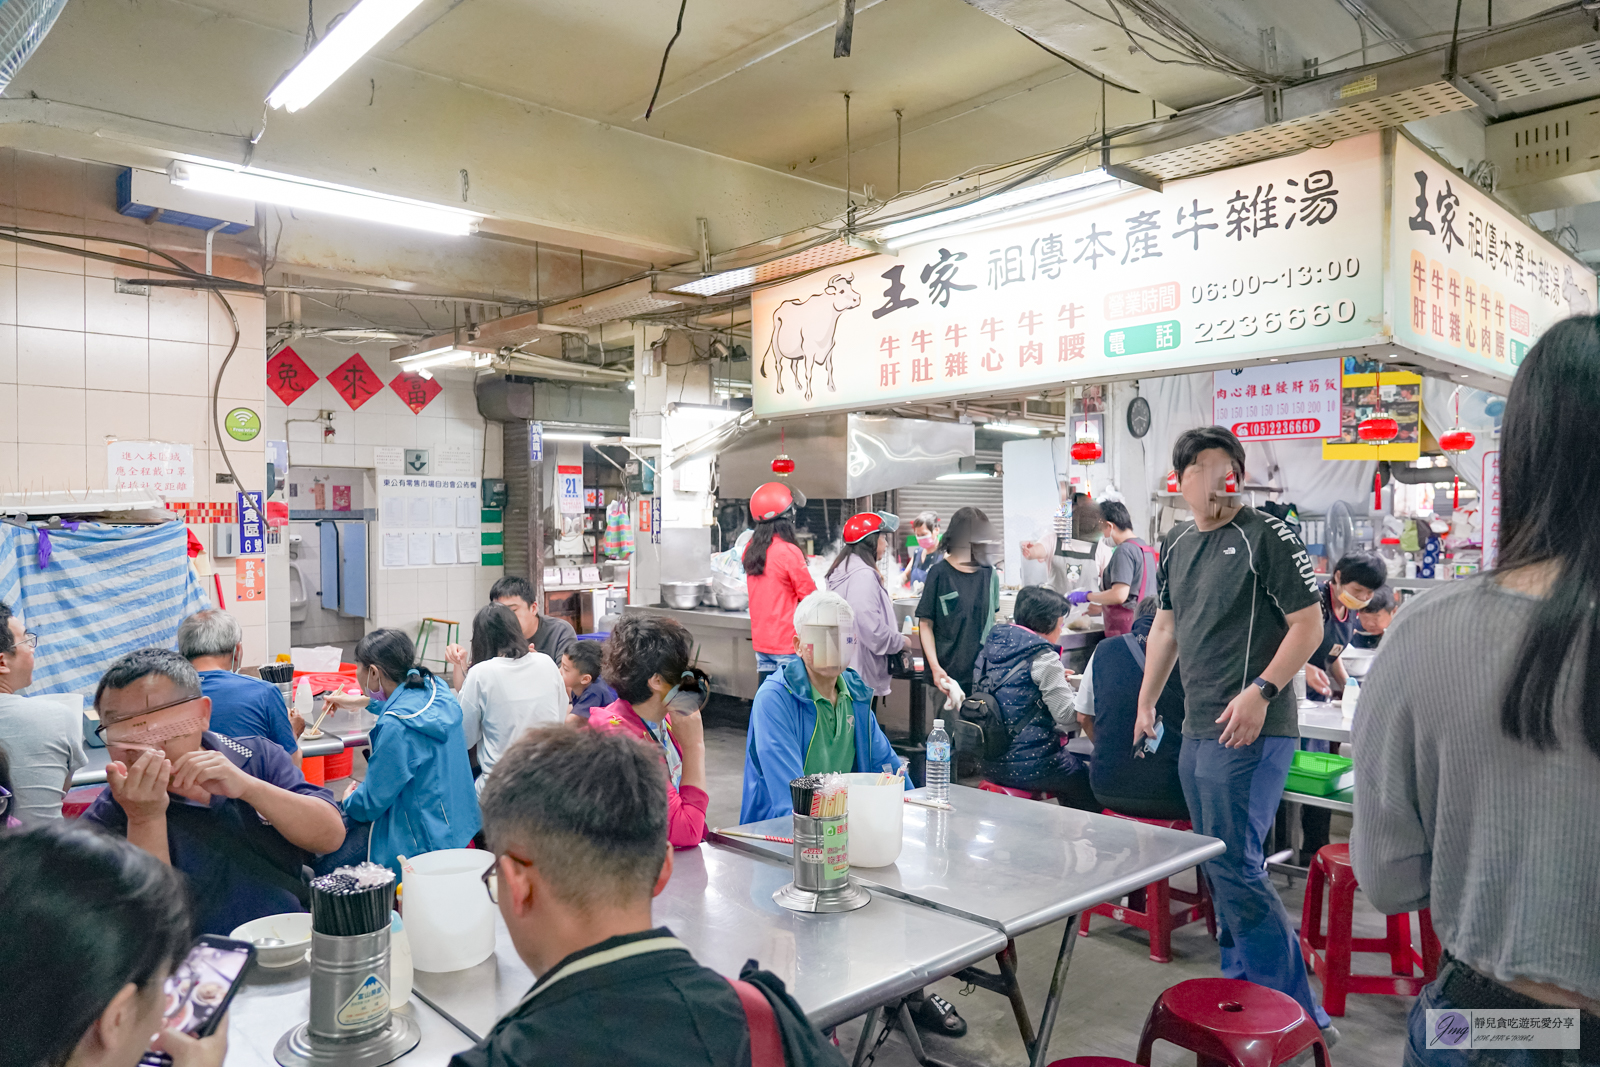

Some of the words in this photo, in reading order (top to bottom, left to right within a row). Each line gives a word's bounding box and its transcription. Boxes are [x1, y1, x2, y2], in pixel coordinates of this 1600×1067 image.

[871, 248, 977, 319] 王家
[987, 170, 1339, 291] 祖傳本產牛雜湯
[1408, 170, 1465, 254] 王家
[1468, 211, 1560, 306] 祖傳本產牛雜湯
[1108, 284, 1176, 318] 營業時間
[1190, 256, 1361, 305] 06:00~13:00
[979, 317, 1005, 372] 牛心
[1018, 310, 1044, 367] 牛肉
[1057, 302, 1086, 362] 牛腰
[1194, 299, 1357, 345] 2236660
[879, 335, 901, 387] 牛肝
[911, 329, 933, 384] 牛肚
[944, 323, 969, 378] 牛雜
[1250, 419, 1316, 436] (05)2236660
[565, 478, 577, 494] 21
[1291, 550, 1319, 592] RUN
